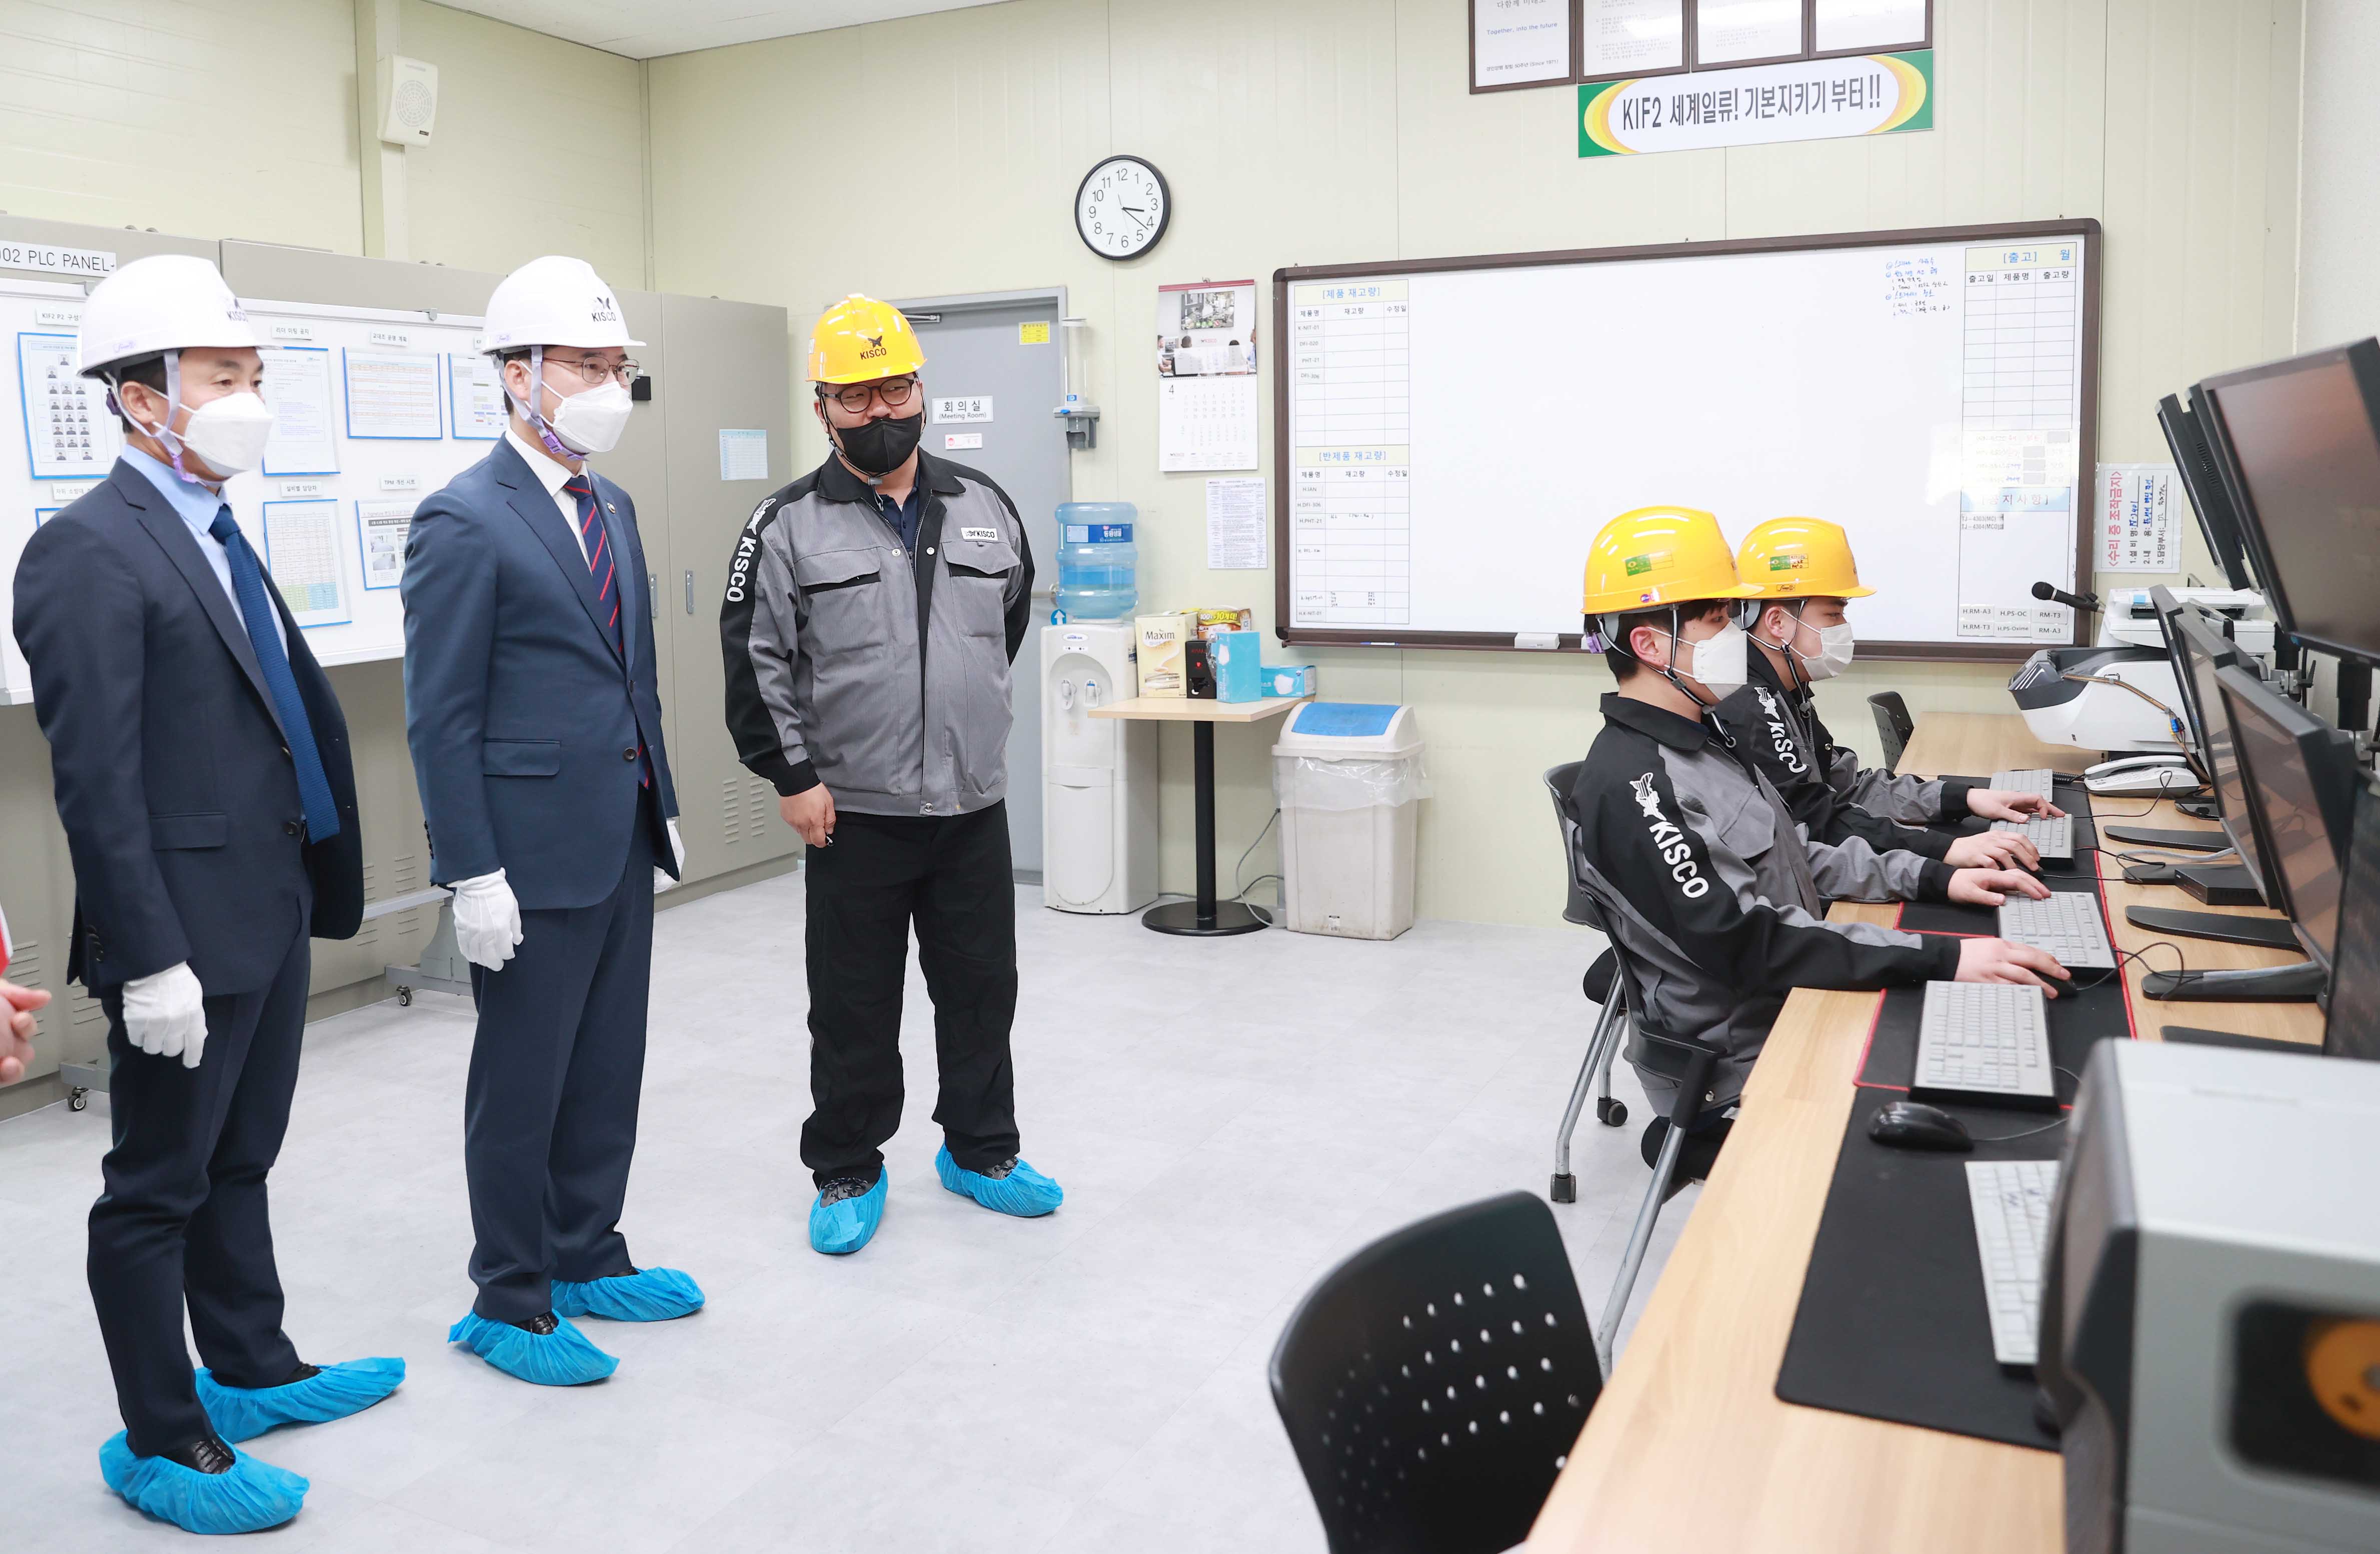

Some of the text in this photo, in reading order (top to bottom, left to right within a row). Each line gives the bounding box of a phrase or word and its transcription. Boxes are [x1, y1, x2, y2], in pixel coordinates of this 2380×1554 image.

[1623, 96, 1661, 130] KIF2
[1669, 88, 1738, 126] 세계일류!
[1744, 80, 1825, 119] 기본지키기
[1116, 168, 1128, 181] 12
[1135, 172, 1139, 184] 1
[1102, 176, 1111, 188] 11
[1146, 183, 1153, 195] 2
[1092, 190, 1104, 202] 10
[1151, 198, 1158, 210] 3
[1089, 206, 1096, 218] 9
[1094, 222, 1102, 234] 8
[1147, 216, 1154, 228] 4
[1107, 233, 1114, 244] 7
[1121, 236, 1129, 248] 6
[1136, 230, 1143, 242] 5
[0, 248, 21, 263] 02
[29, 250, 55, 266] PLC
[2003, 248, 2070, 264] [출고] 월
[1968, 274, 1994, 282] 출고일
[2004, 272, 2029, 281] 제품명
[2043, 270, 2069, 279] 출고량
[1323, 286, 1380, 300] [제품 재고량]
[592, 312, 616, 322] KISCO
[860, 348, 887, 360] KISCO
[1169, 384, 1174, 394] 4
[939, 412, 965, 420] (Meeting
[1319, 450, 1386, 462] [반제품 재고량]
[2109, 471, 2123, 520] 조작금지>
[976, 530, 995, 538] KISCO
[2108, 540, 2121, 566] <수리
[727, 536, 757, 602] KISCO
[1145, 631, 1175, 640] Maxim
[1649, 821, 1709, 898] KISCO
